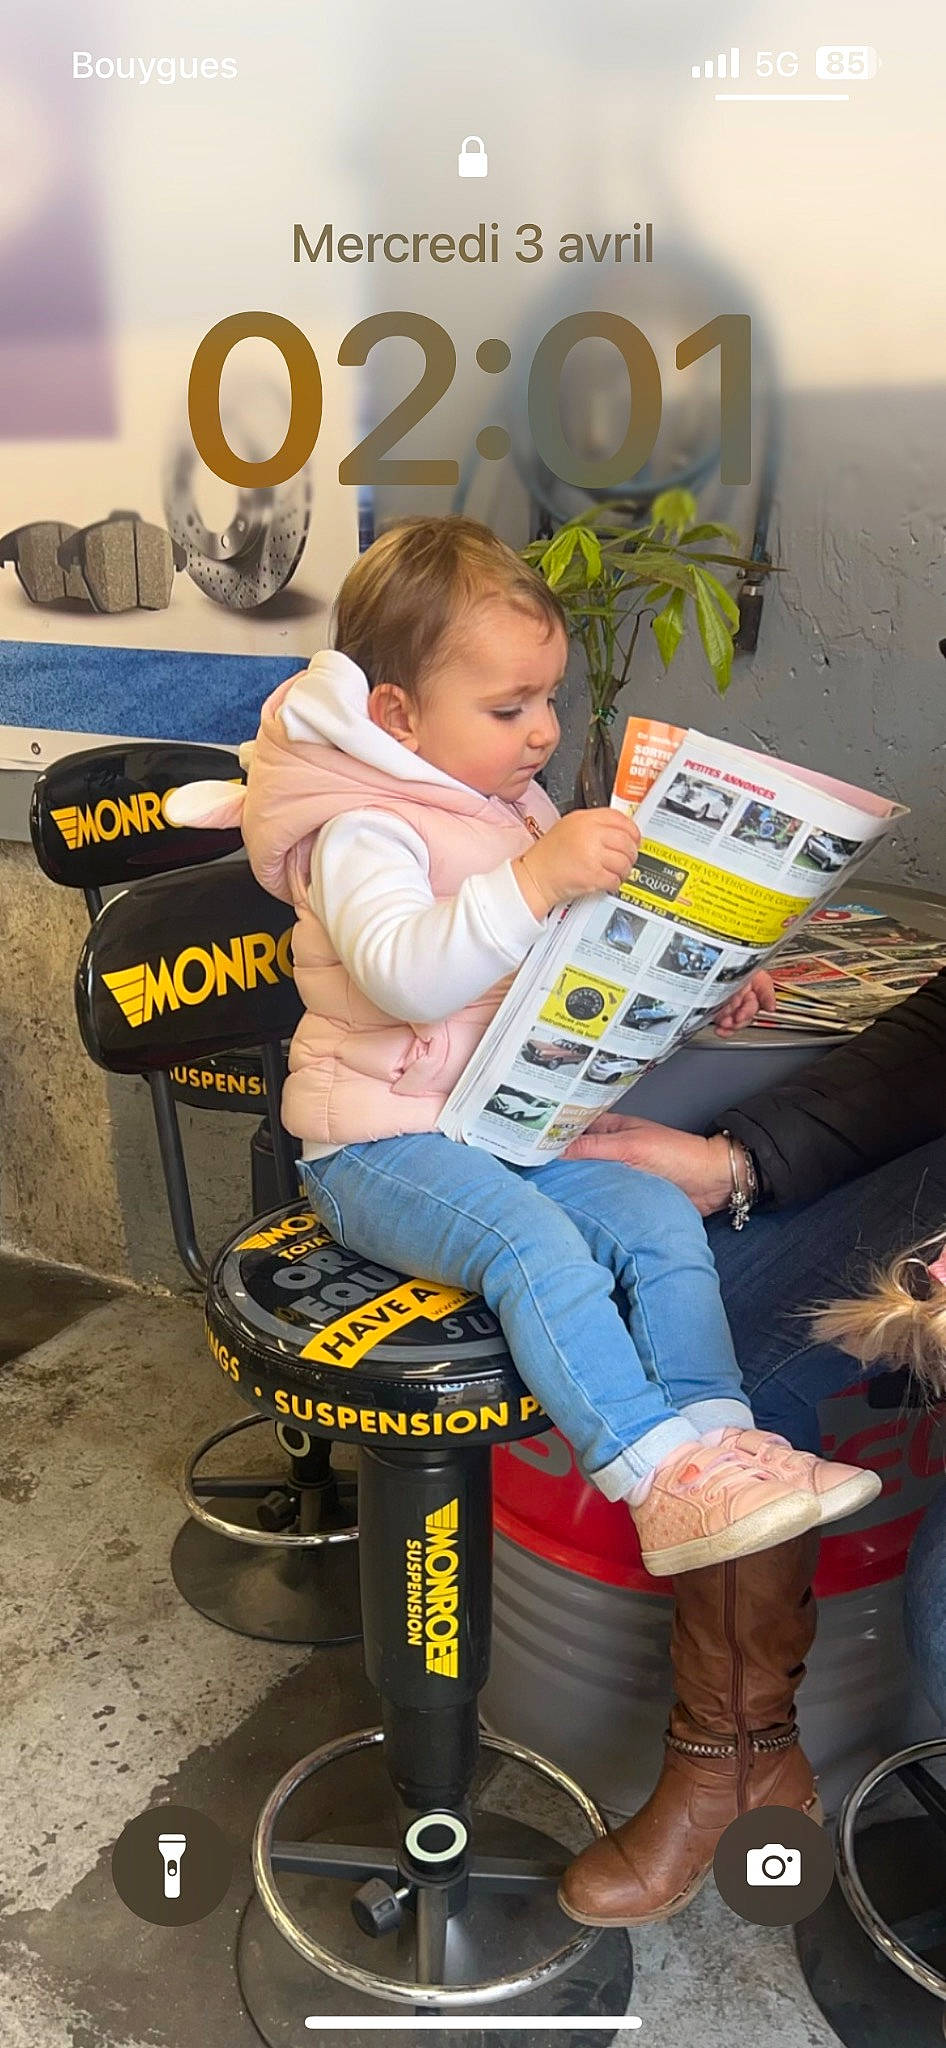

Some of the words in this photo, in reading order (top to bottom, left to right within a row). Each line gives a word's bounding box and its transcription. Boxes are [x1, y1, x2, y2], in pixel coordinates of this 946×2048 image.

[683, 759, 722, 778] PETITES
[722, 773, 777, 801] ANNONCES
[320, 1299, 412, 1360] HAVE
[410, 1287, 440, 1304] A
[274, 1388, 509, 1436] SUSPENSION
[406, 1538, 423, 1646] SUSPENSION
[425, 1498, 459, 1678] MONROE
